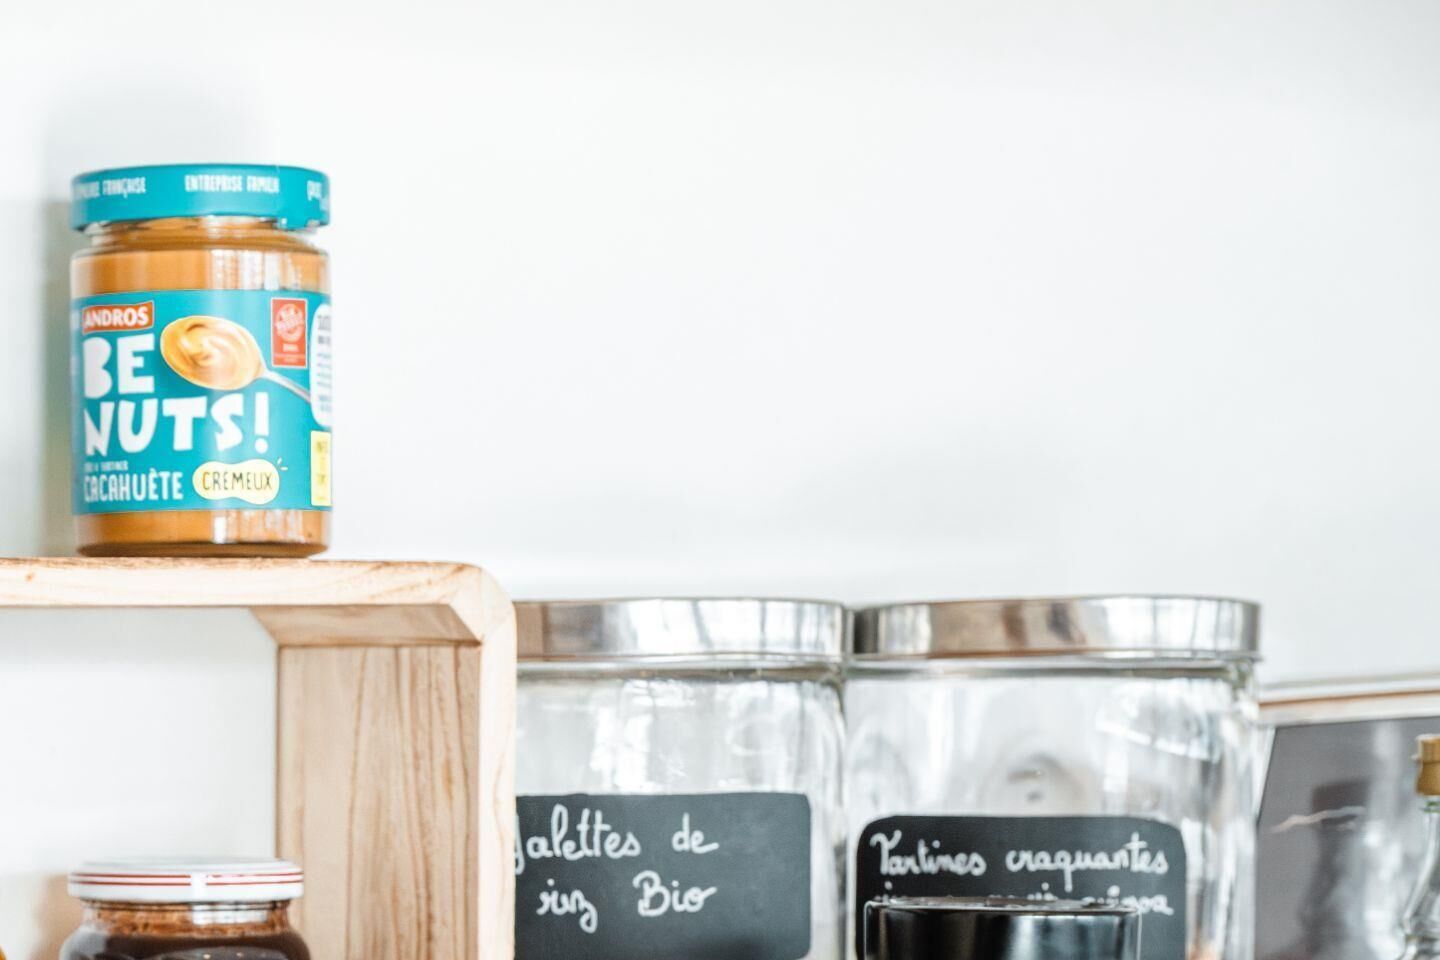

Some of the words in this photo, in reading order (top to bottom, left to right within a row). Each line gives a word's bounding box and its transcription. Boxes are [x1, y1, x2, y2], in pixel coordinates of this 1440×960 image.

[184, 174, 242, 192] ENTREPRISE
[84, 305, 149, 328] ANDROS
[83, 332, 155, 399] BE
[83, 391, 271, 457] NUTS!
[83, 467, 185, 502] CACAHUÈTE
[672, 812, 720, 854] de
[870, 829, 988, 877] Tartines
[1005, 831, 1170, 893] craquantes
[632, 869, 718, 917] Bio
